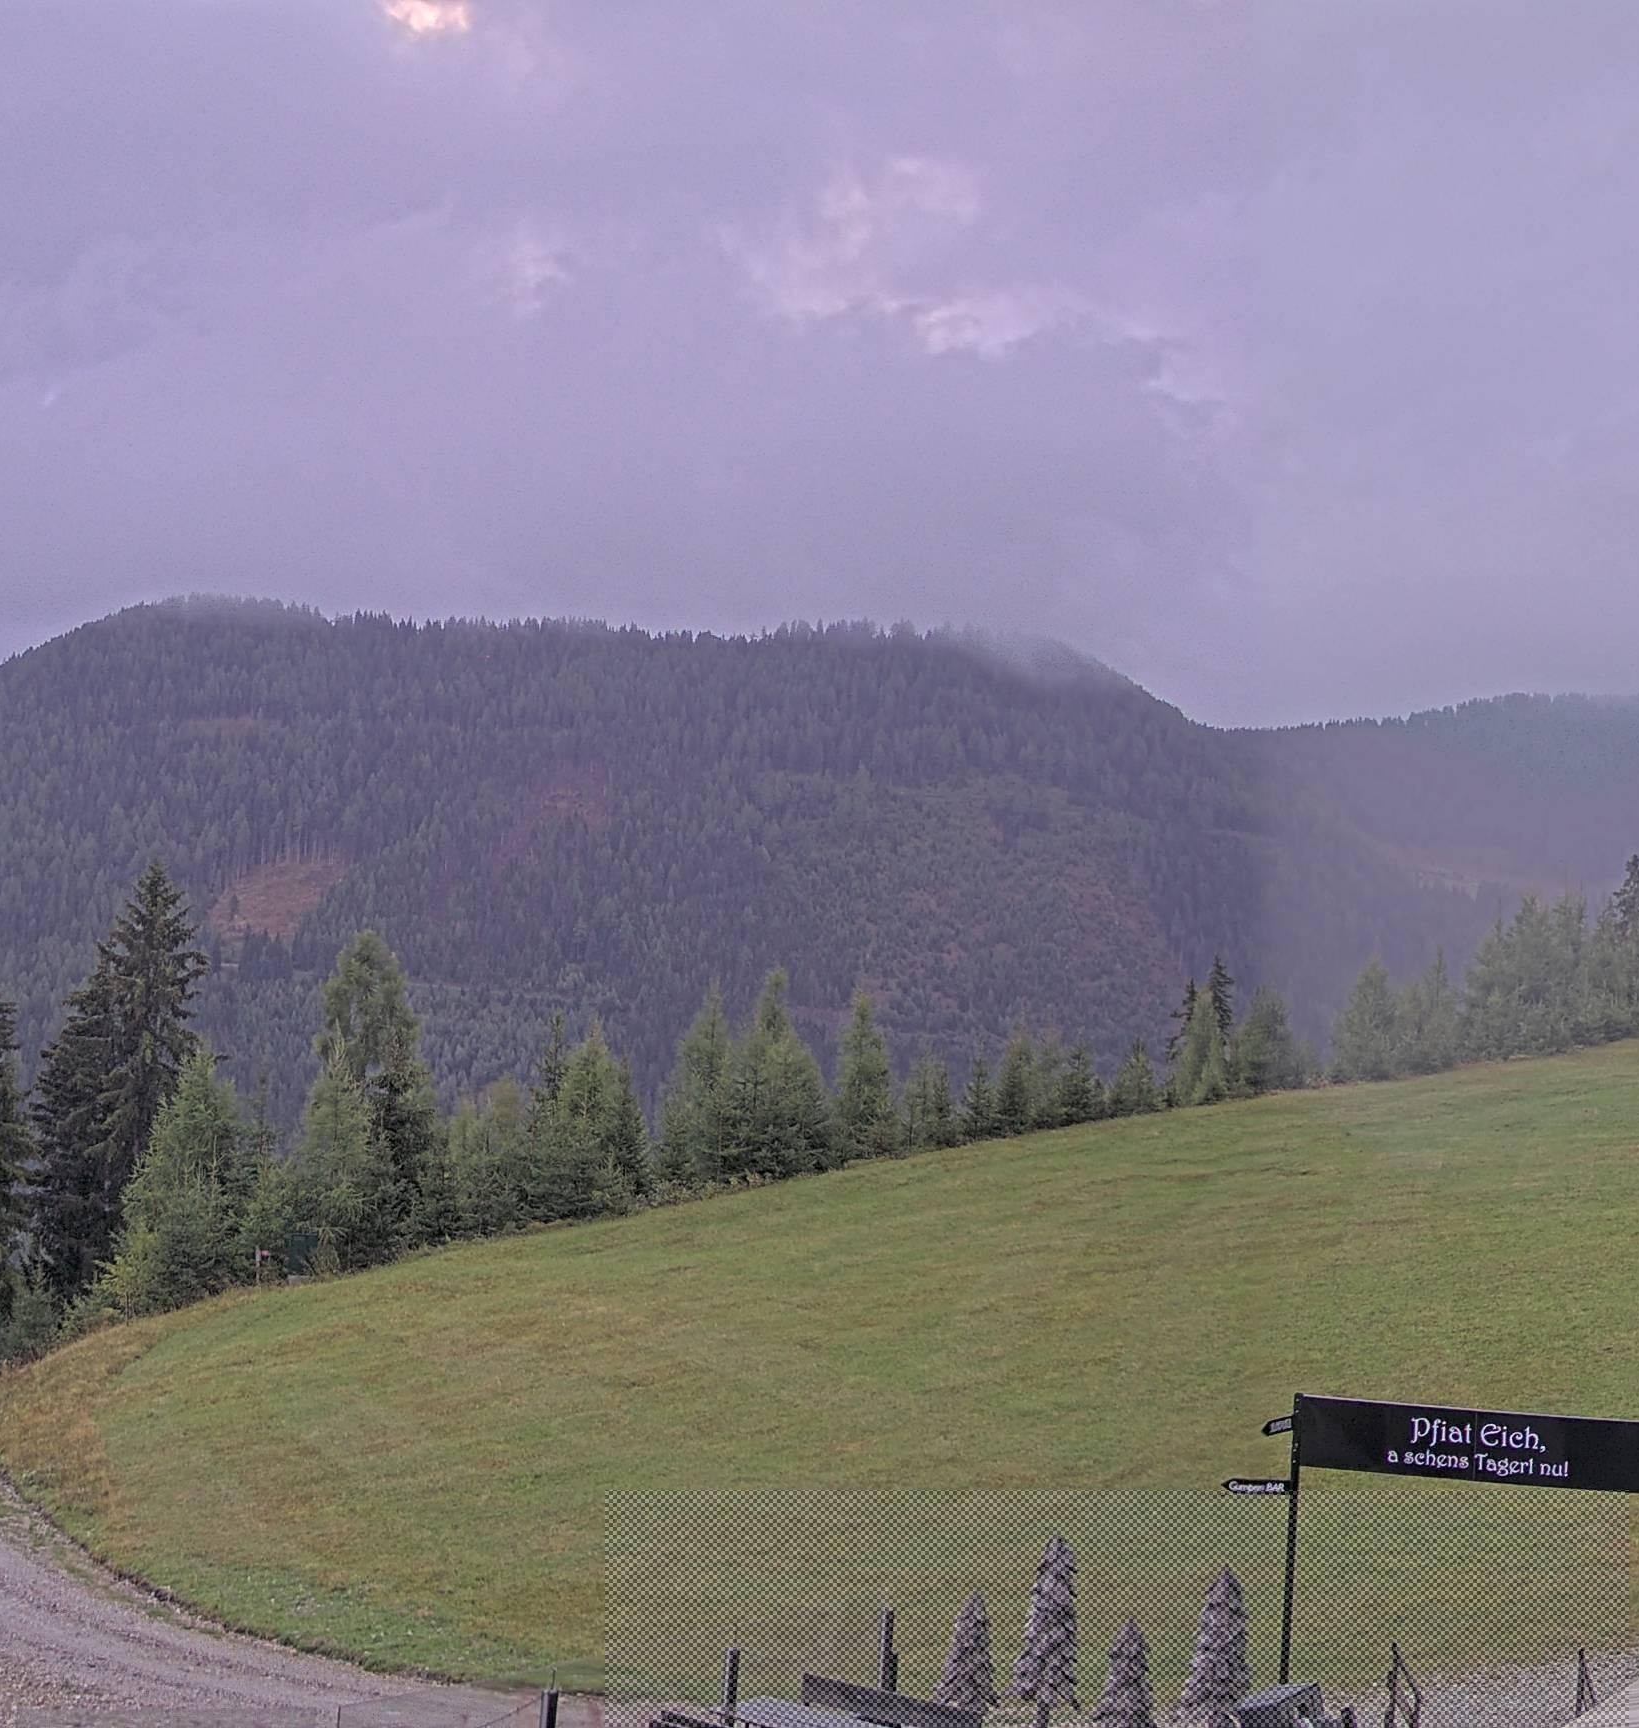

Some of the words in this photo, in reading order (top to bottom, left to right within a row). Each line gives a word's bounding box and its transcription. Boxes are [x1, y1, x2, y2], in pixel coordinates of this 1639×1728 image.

[1410, 1417, 1472, 1447] Pfiat
[1480, 1423, 1546, 1453] Eich,
[1387, 1450, 1398, 1463] a
[1403, 1450, 1469, 1469] schens
[1474, 1453, 1533, 1477] Tagerl
[1539, 1461, 1569, 1477] nu!
[1265, 1482, 1284, 1492] BAR
